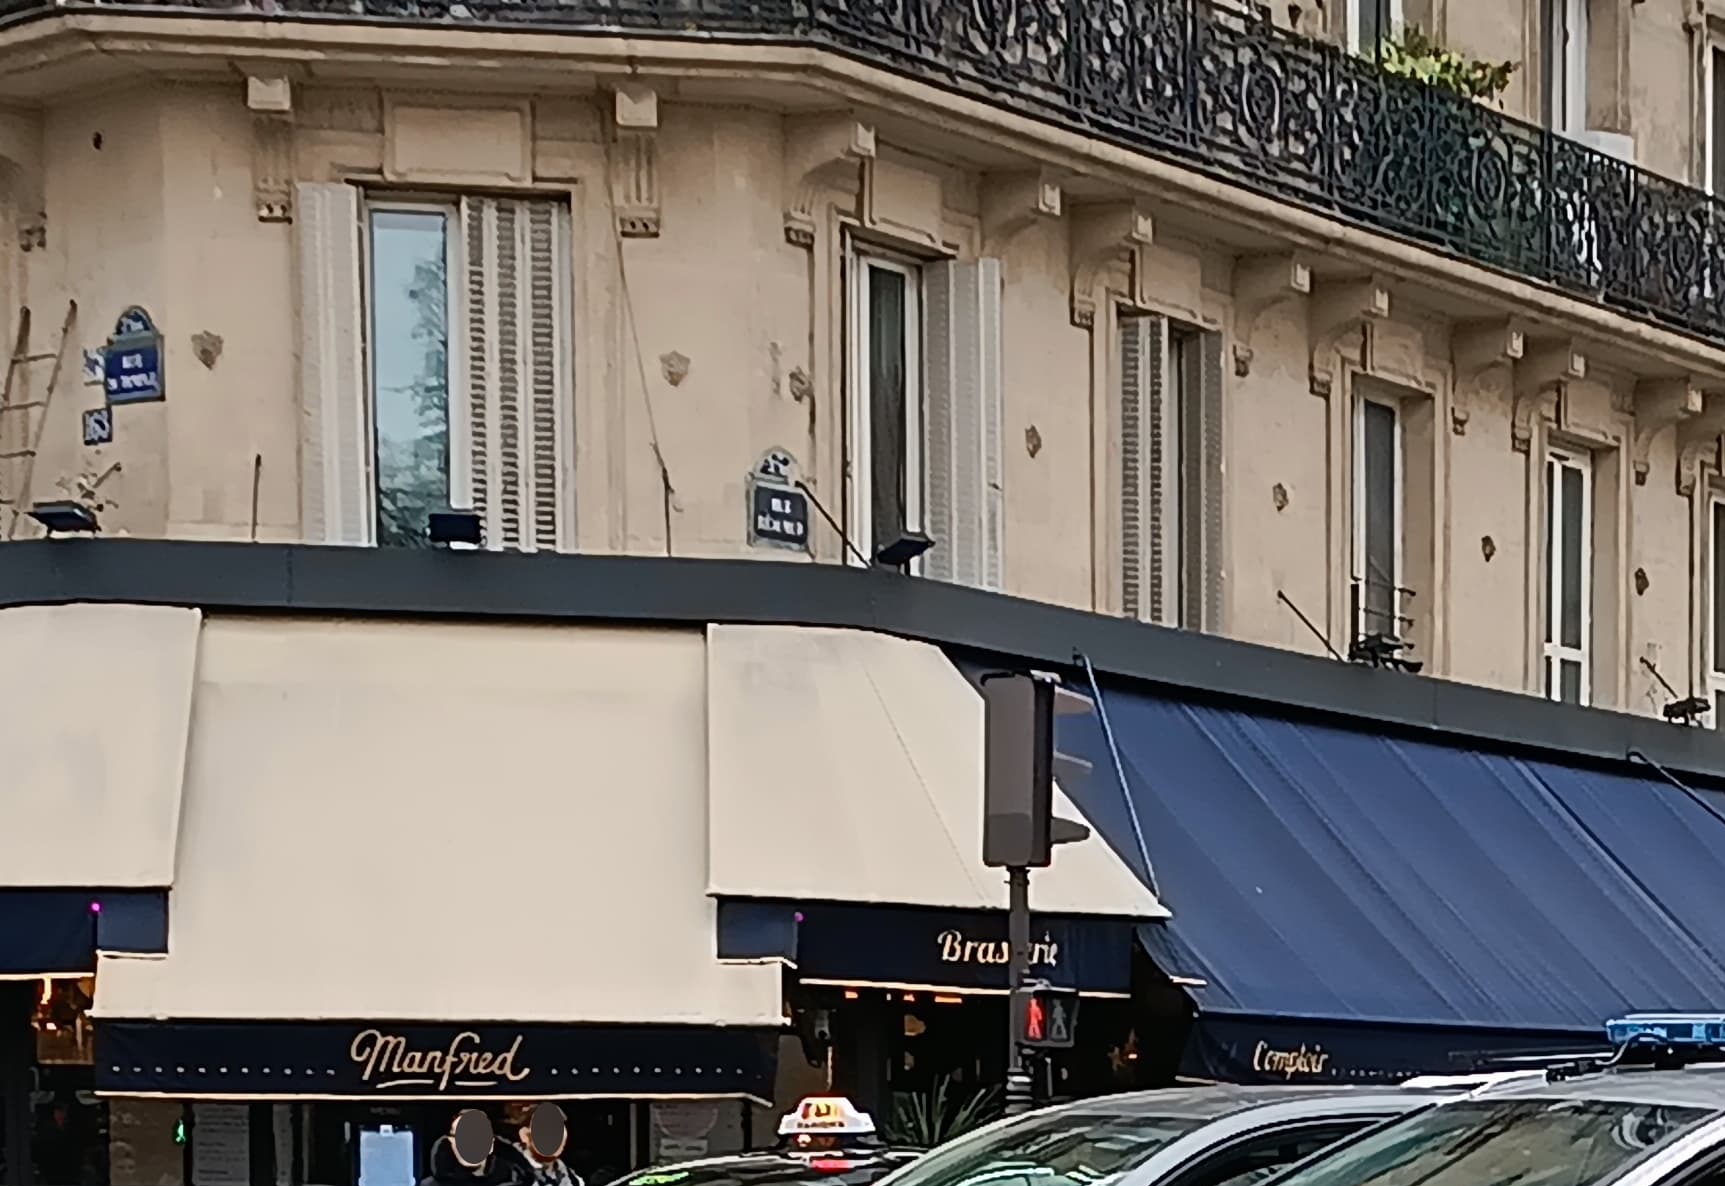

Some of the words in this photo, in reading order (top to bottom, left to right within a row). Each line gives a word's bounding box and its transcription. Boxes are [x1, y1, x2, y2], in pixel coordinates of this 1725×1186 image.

[937, 929, 1059, 967] Brasrie
[351, 1029, 531, 1091] Manfred
[1253, 1040, 1328, 1080] Comptoir
